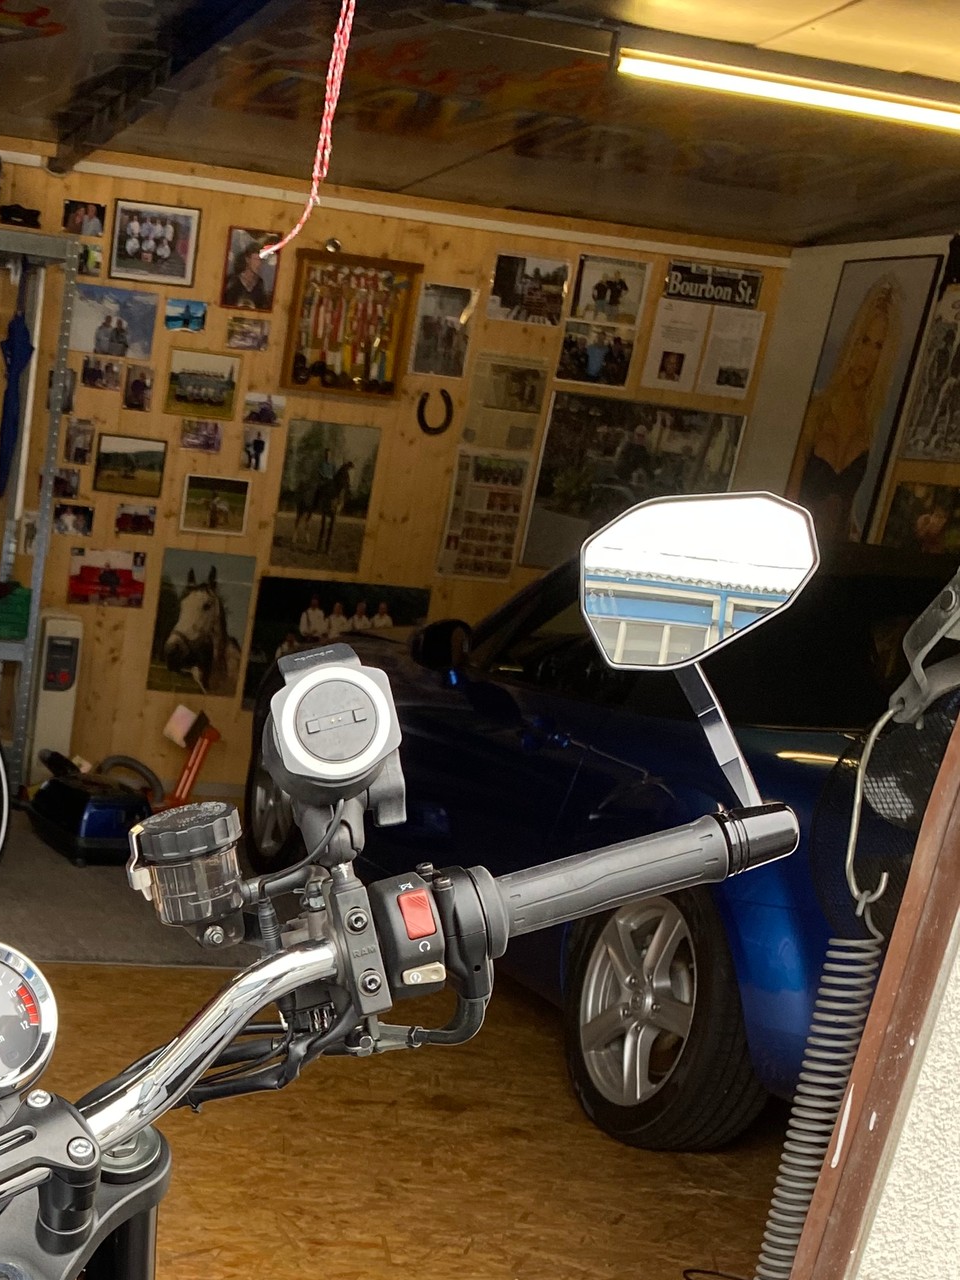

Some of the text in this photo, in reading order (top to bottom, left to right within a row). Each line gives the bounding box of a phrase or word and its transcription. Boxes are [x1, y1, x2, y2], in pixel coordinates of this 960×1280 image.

[668, 270, 755, 304] Bourbon St.
[351, 945, 377, 959] RAM
[8, 990, 17, 998] 10
[17, 1004, 27, 1012] 11
[20, 1020, 30, 1030] 12
